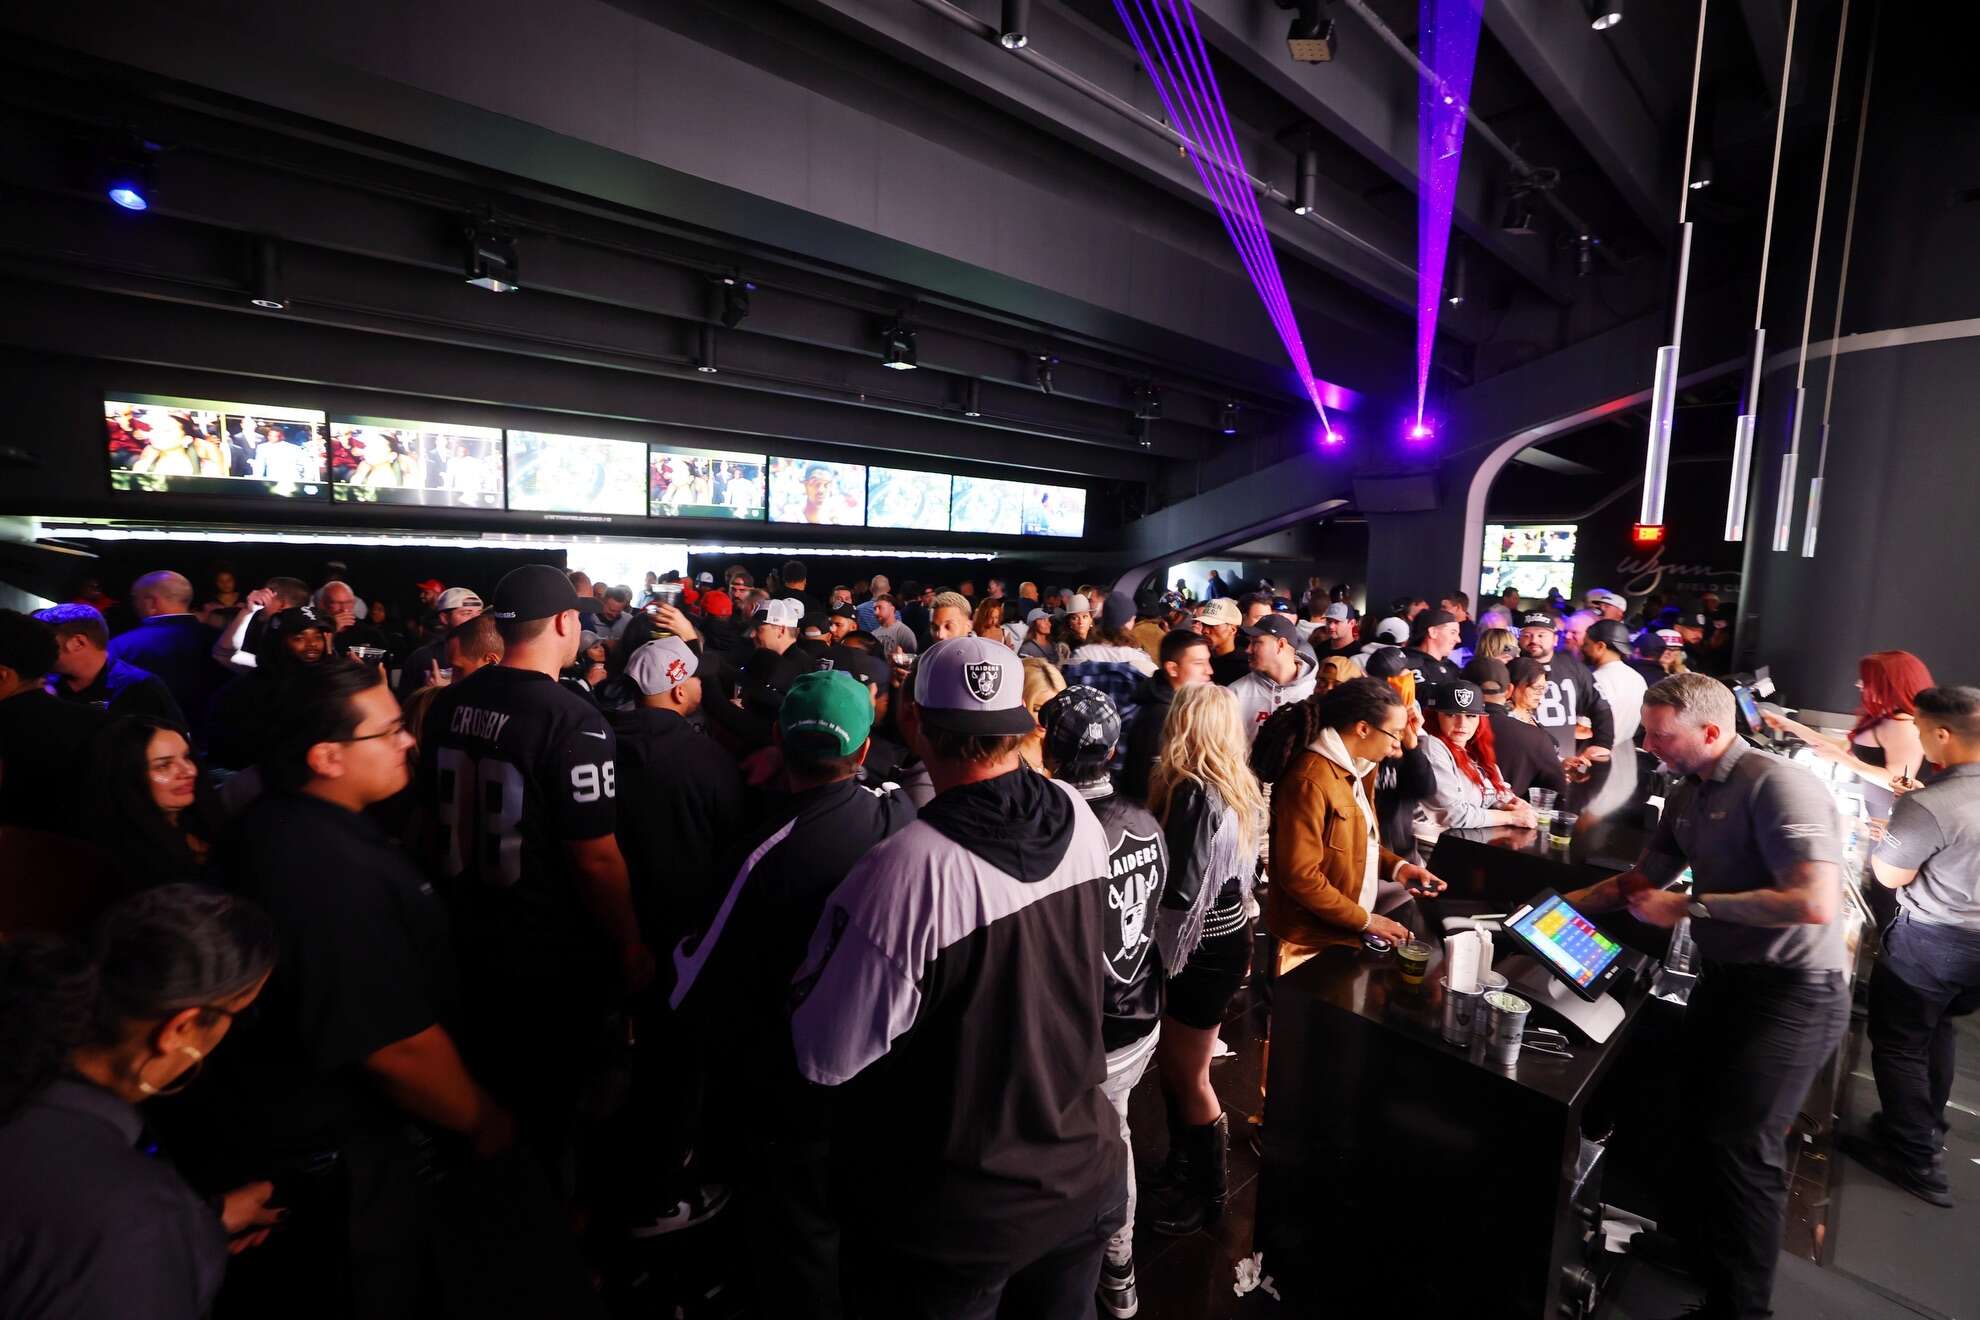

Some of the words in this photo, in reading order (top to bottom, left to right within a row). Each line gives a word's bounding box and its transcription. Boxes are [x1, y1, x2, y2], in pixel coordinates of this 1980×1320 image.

[451, 704, 510, 741] CROSBY
[1537, 678, 1577, 727] 81
[571, 760, 616, 804] 98
[436, 746, 526, 889] 98
